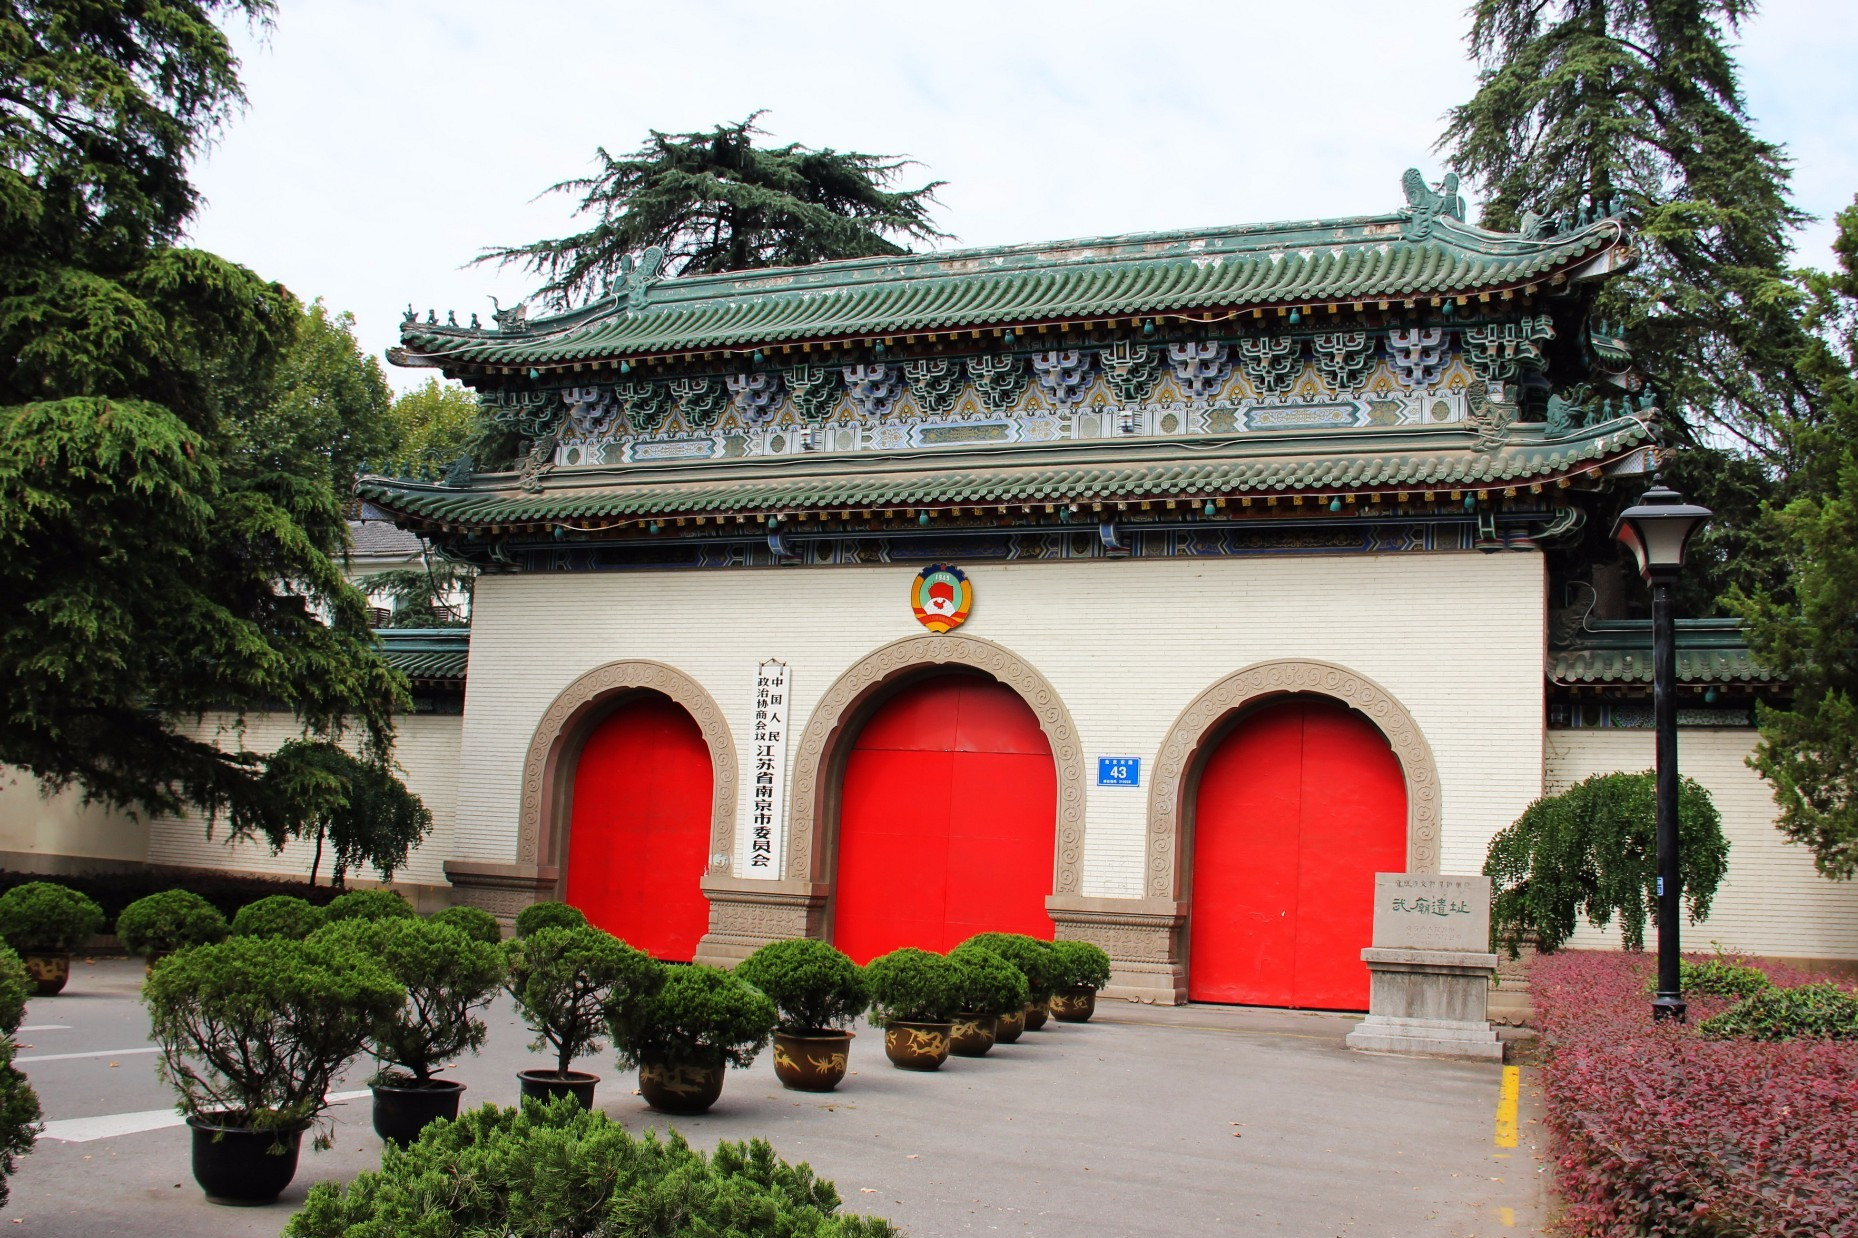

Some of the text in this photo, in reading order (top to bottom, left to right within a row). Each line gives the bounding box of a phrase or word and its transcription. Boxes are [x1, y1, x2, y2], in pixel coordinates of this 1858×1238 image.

[754, 677, 770, 742] 政治协商会议
[768, 677, 784, 742] 中国人民
[1110, 766, 1127, 778] 43
[751, 744, 775, 867] 江苏省南京市委员会
